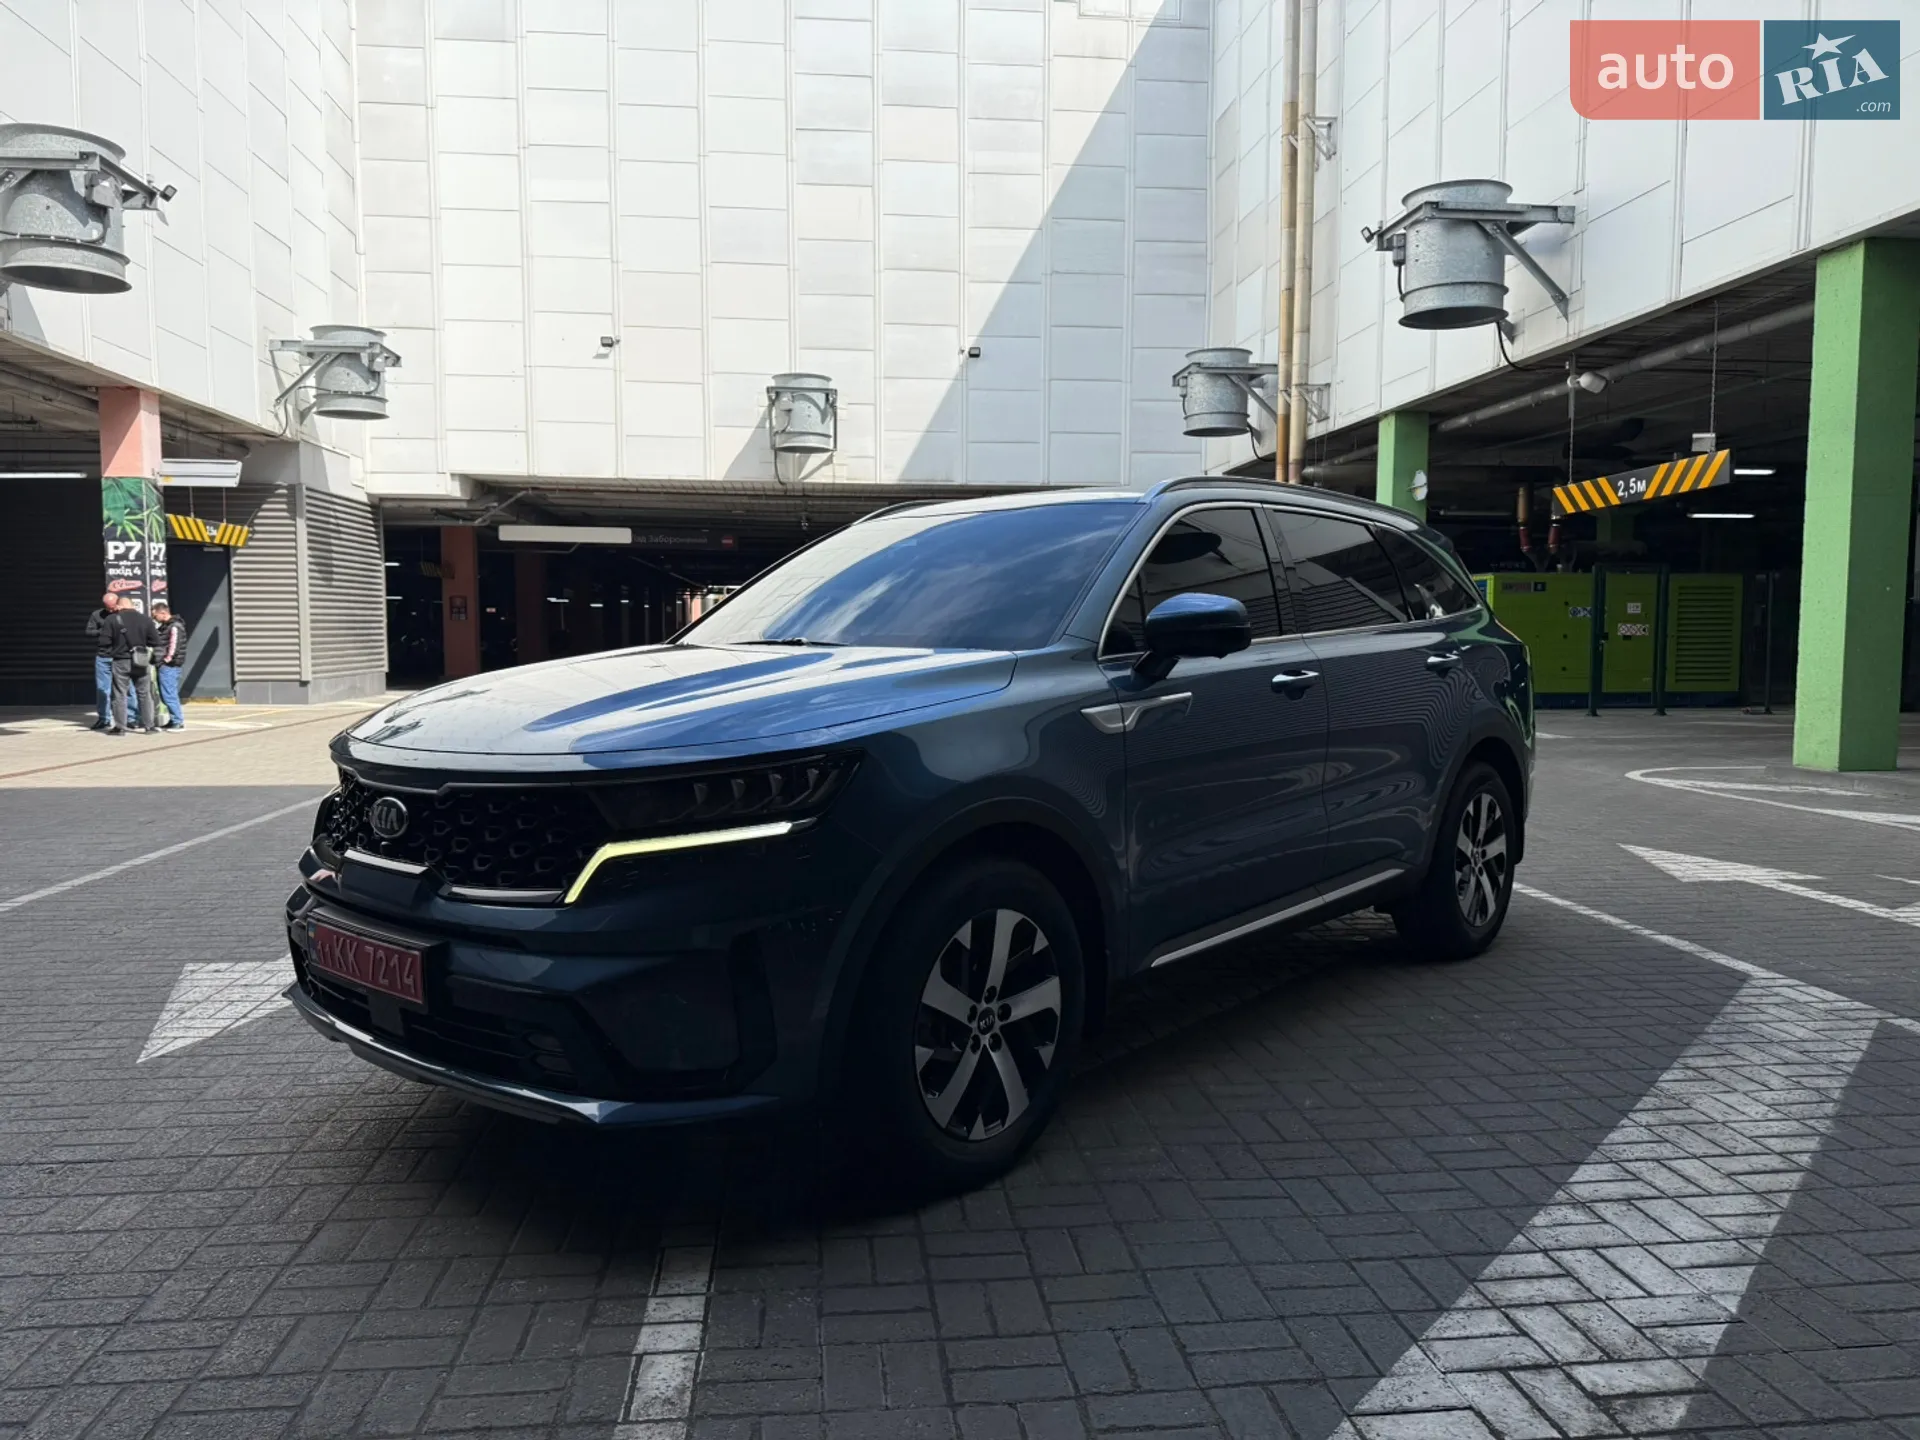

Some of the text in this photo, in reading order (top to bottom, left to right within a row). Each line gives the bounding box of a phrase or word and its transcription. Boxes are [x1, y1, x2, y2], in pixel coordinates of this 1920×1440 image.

[108, 541, 142, 560] P7
[133, 566, 142, 576] 4
[370, 805, 399, 831] KIA
[364, 945, 415, 993] 7214
[979, 1014, 995, 1030] KIA
